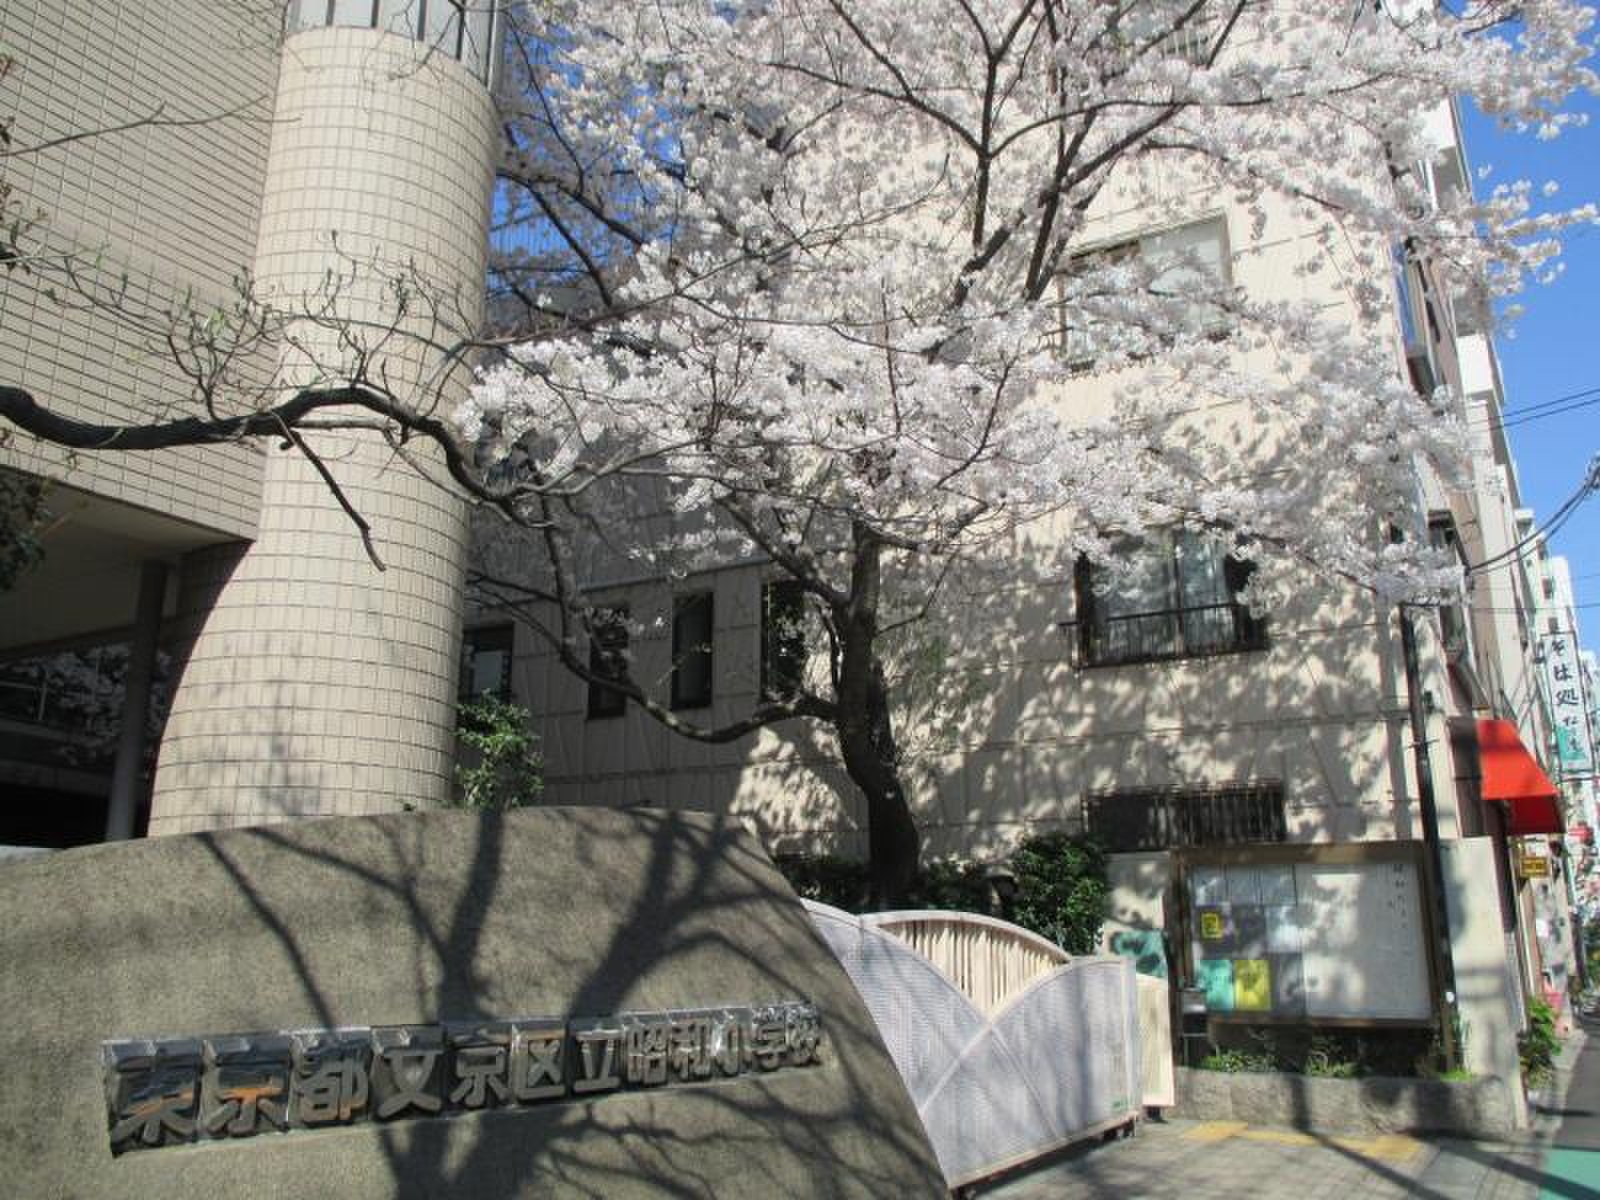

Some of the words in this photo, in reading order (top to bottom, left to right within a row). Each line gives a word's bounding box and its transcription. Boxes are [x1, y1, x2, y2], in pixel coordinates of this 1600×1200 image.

[108, 1004, 822, 1149] 東京都文京区立昭和小学校
